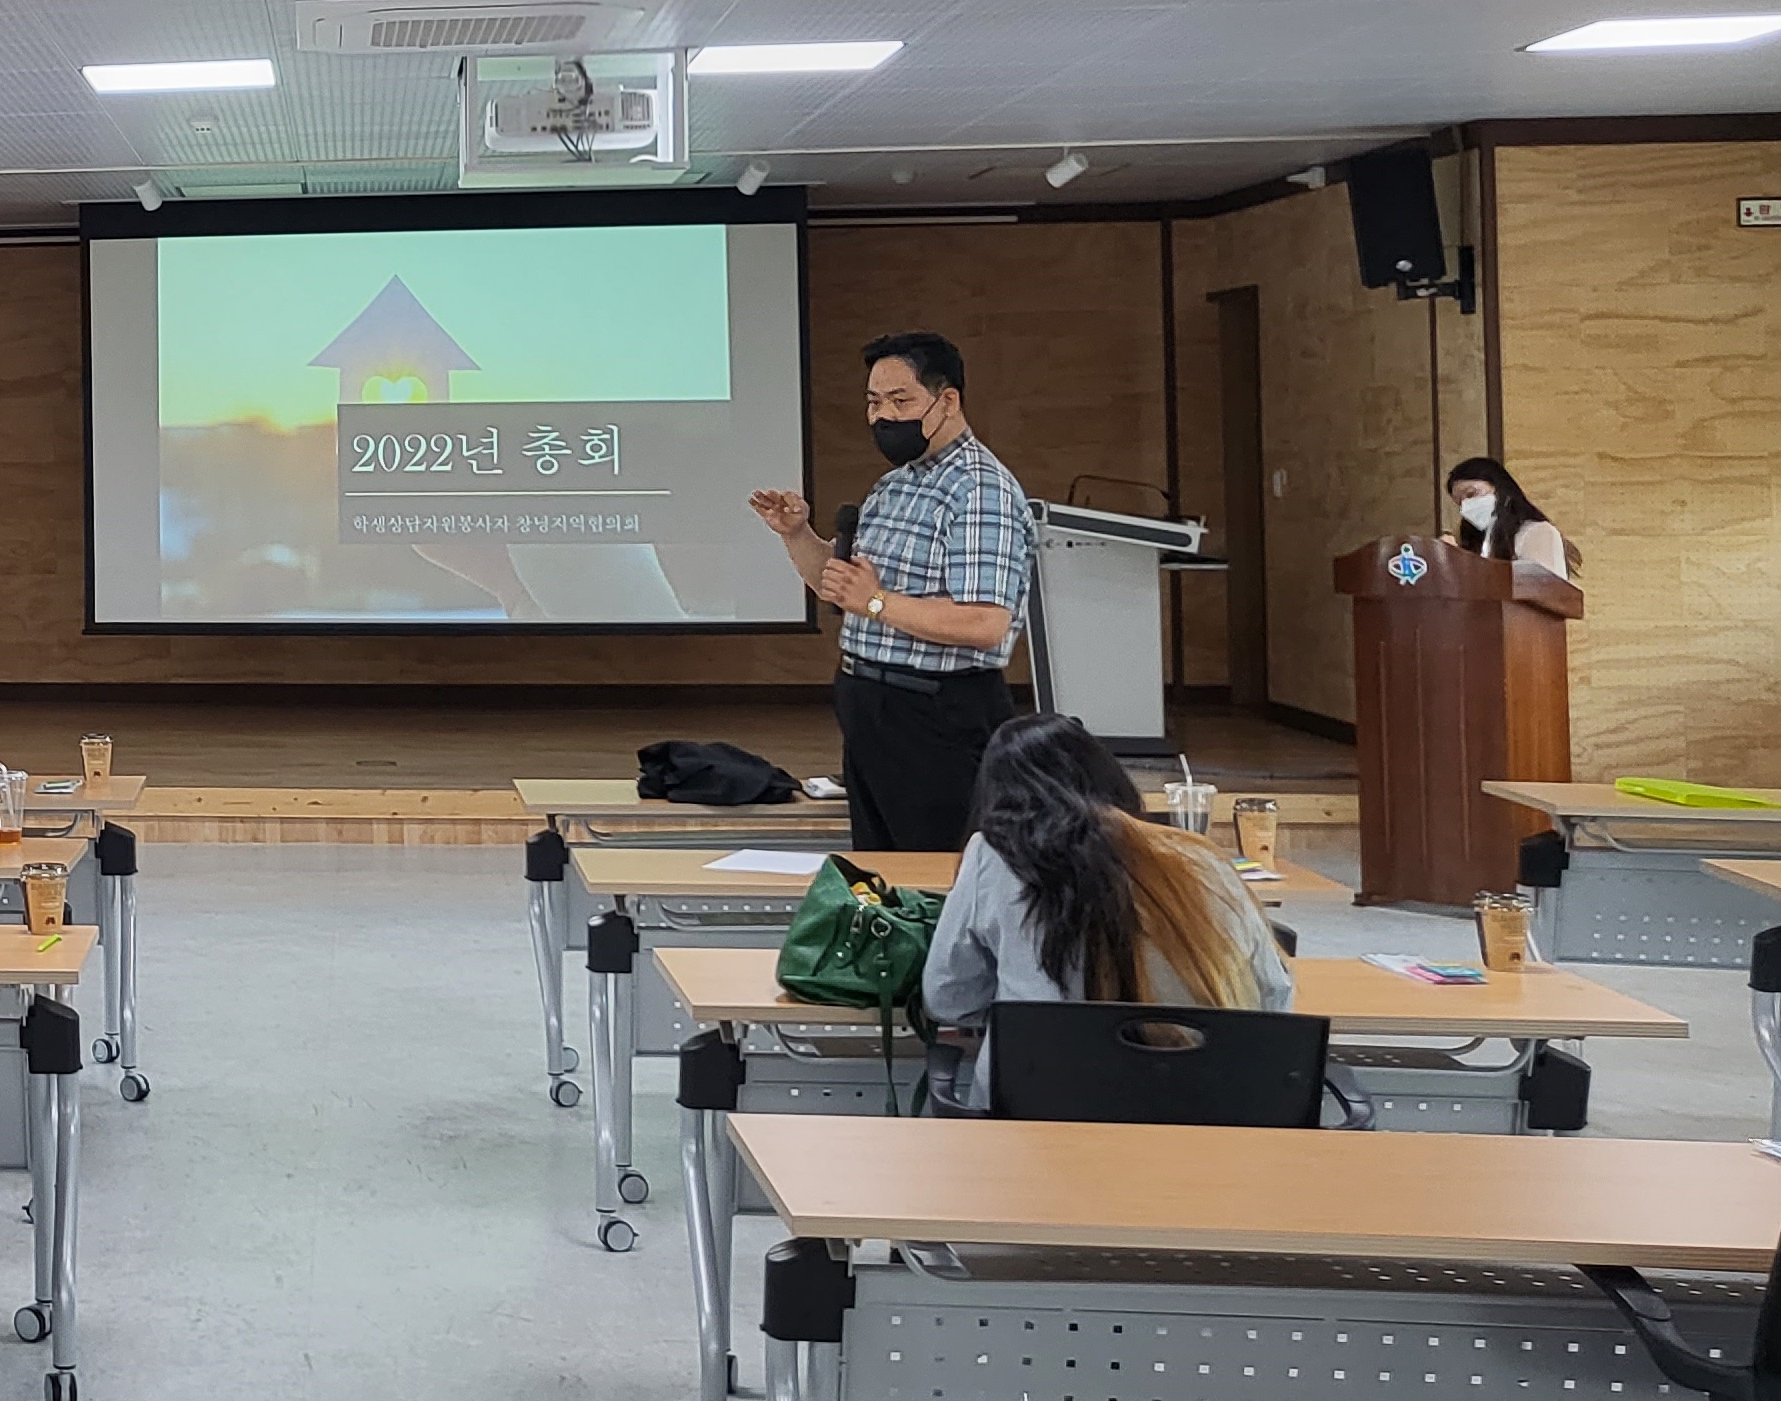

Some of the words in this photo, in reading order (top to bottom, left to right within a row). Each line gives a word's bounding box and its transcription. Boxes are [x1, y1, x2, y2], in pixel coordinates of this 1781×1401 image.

[351, 424, 504, 475] 2022년
[521, 423, 620, 476] 총회
[353, 513, 510, 534] 학생상담자원봉사자
